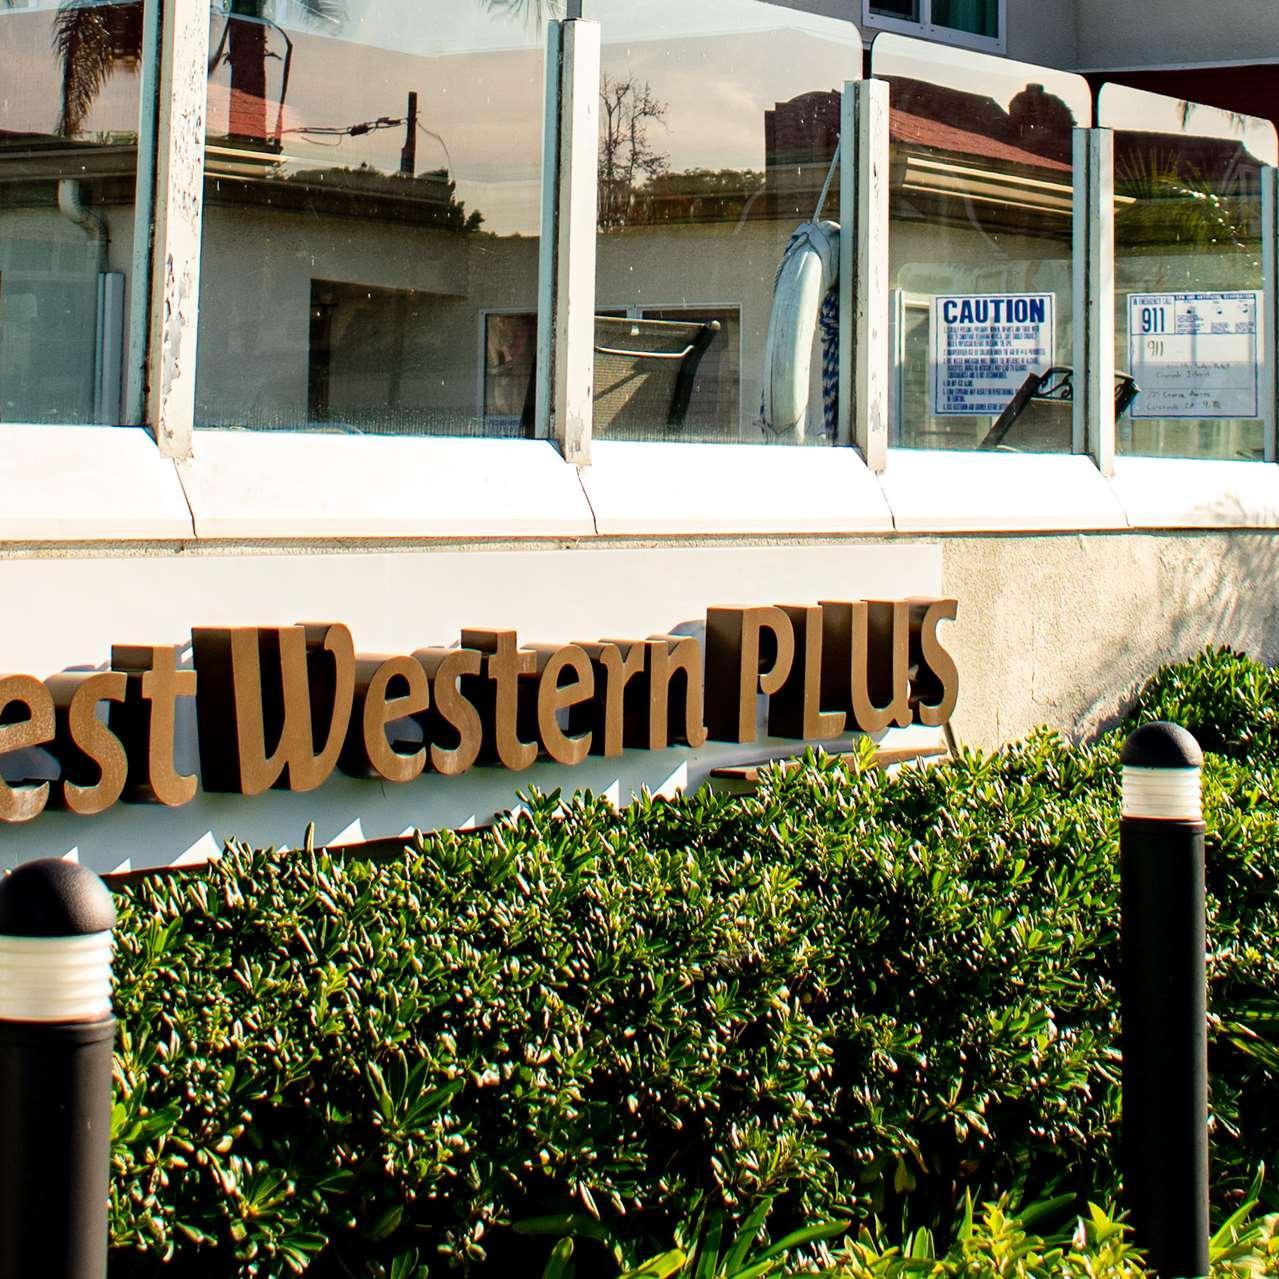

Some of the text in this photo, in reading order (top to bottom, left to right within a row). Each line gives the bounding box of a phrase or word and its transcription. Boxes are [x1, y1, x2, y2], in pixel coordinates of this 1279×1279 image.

[943, 298, 1045, 324] CAUTION
[1142, 307, 1165, 333] 911
[1147, 340, 1164, 357] 911
[192, 621, 708, 796] Western
[706, 597, 960, 743] PLUS
